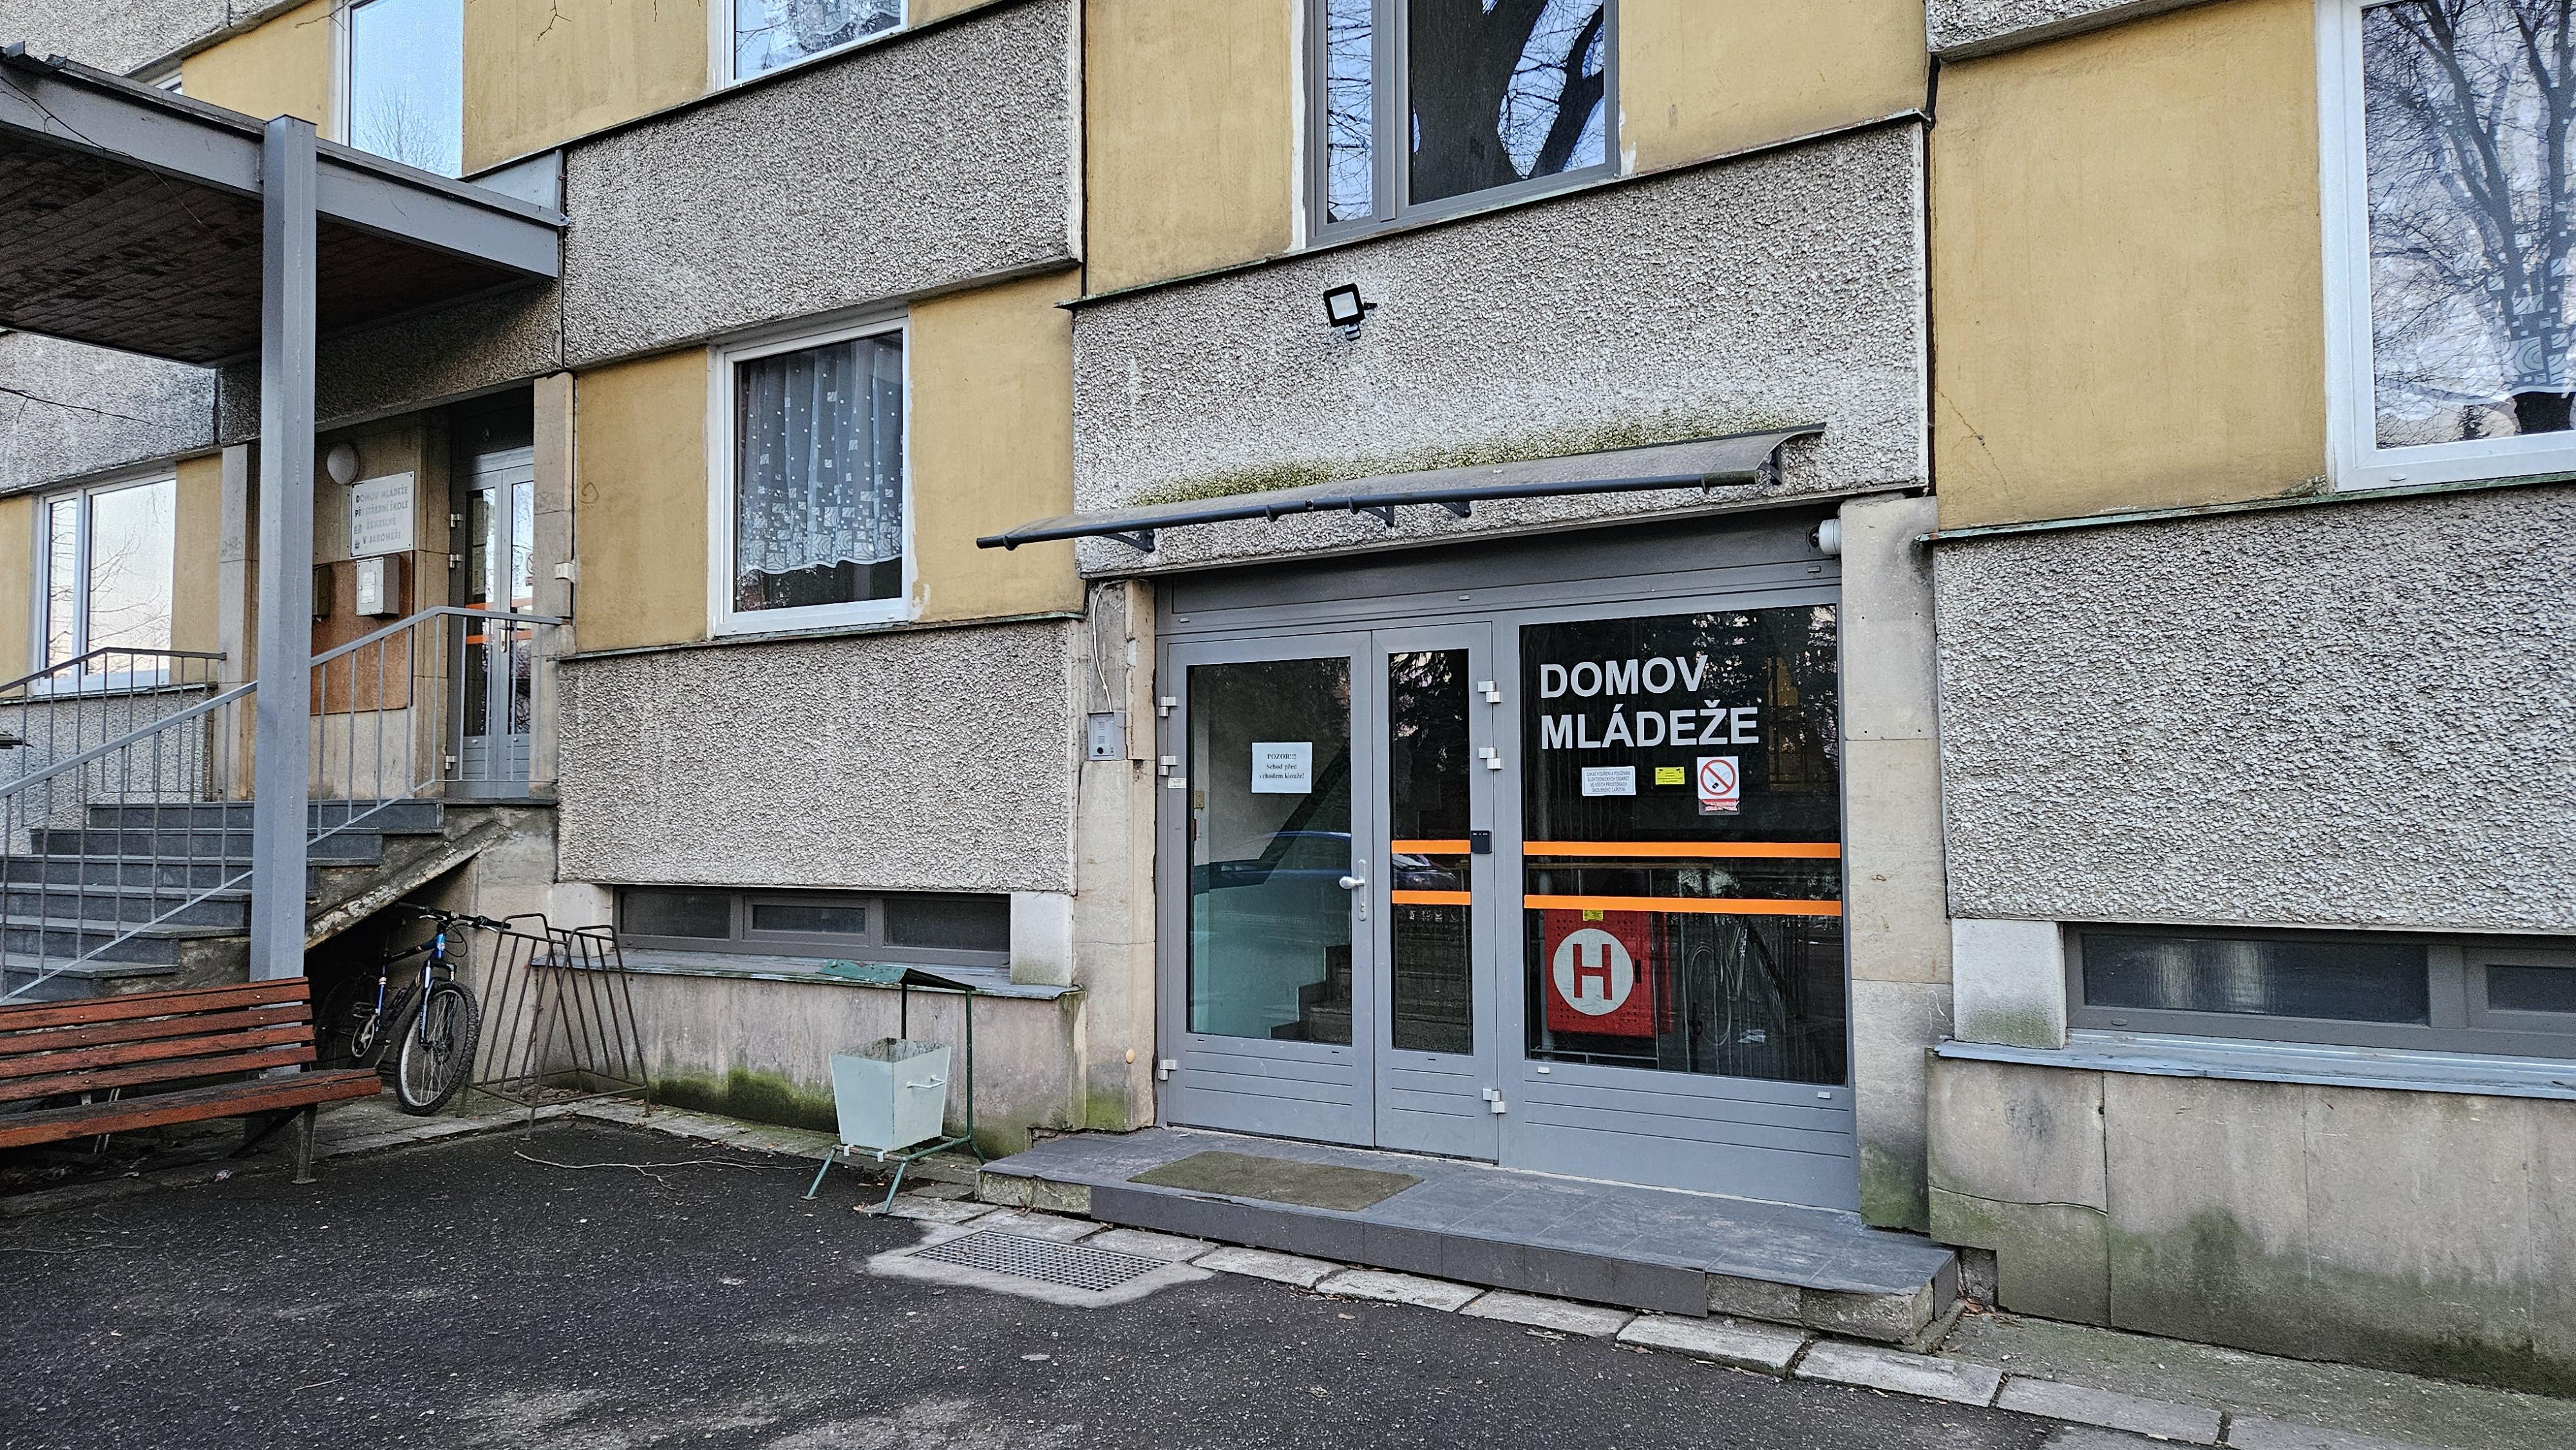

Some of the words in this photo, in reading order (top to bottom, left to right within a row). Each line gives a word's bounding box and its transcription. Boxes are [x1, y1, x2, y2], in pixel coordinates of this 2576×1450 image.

[356, 491, 379, 503] DOMOV
[381, 484, 408, 497] MLÁDEŽE
[390, 500, 408, 511] ŠKOLE
[1540, 655, 1708, 698] DOMOV
[1542, 700, 1759, 749] MLÁDEŽE
[1573, 943, 1613, 1000] H
